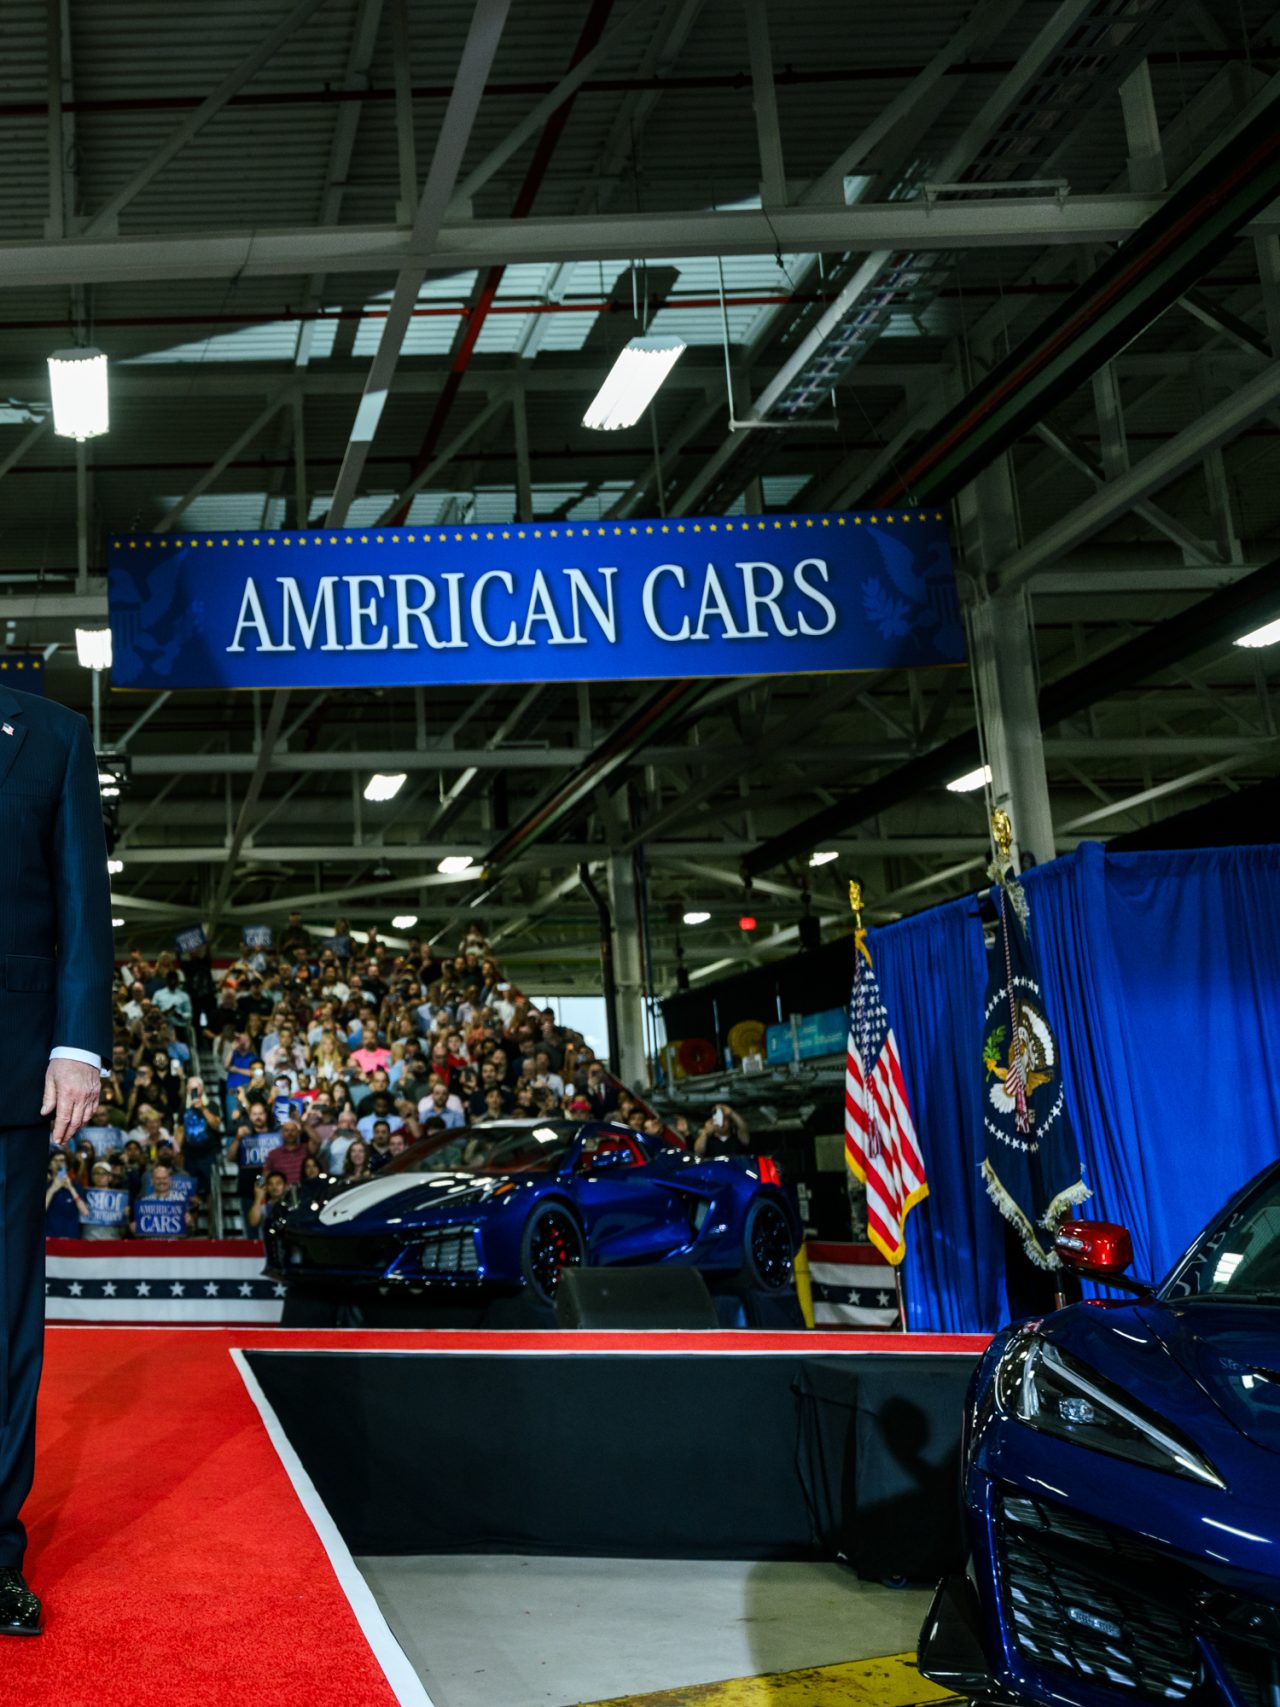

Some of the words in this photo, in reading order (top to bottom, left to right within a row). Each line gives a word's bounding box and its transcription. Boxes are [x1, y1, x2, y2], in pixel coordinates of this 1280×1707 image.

[226, 568, 618, 653] AMERICAN
[641, 558, 837, 642] CARS
[140, 1204, 182, 1215] AMERICAN
[140, 1215, 182, 1233] CARS
